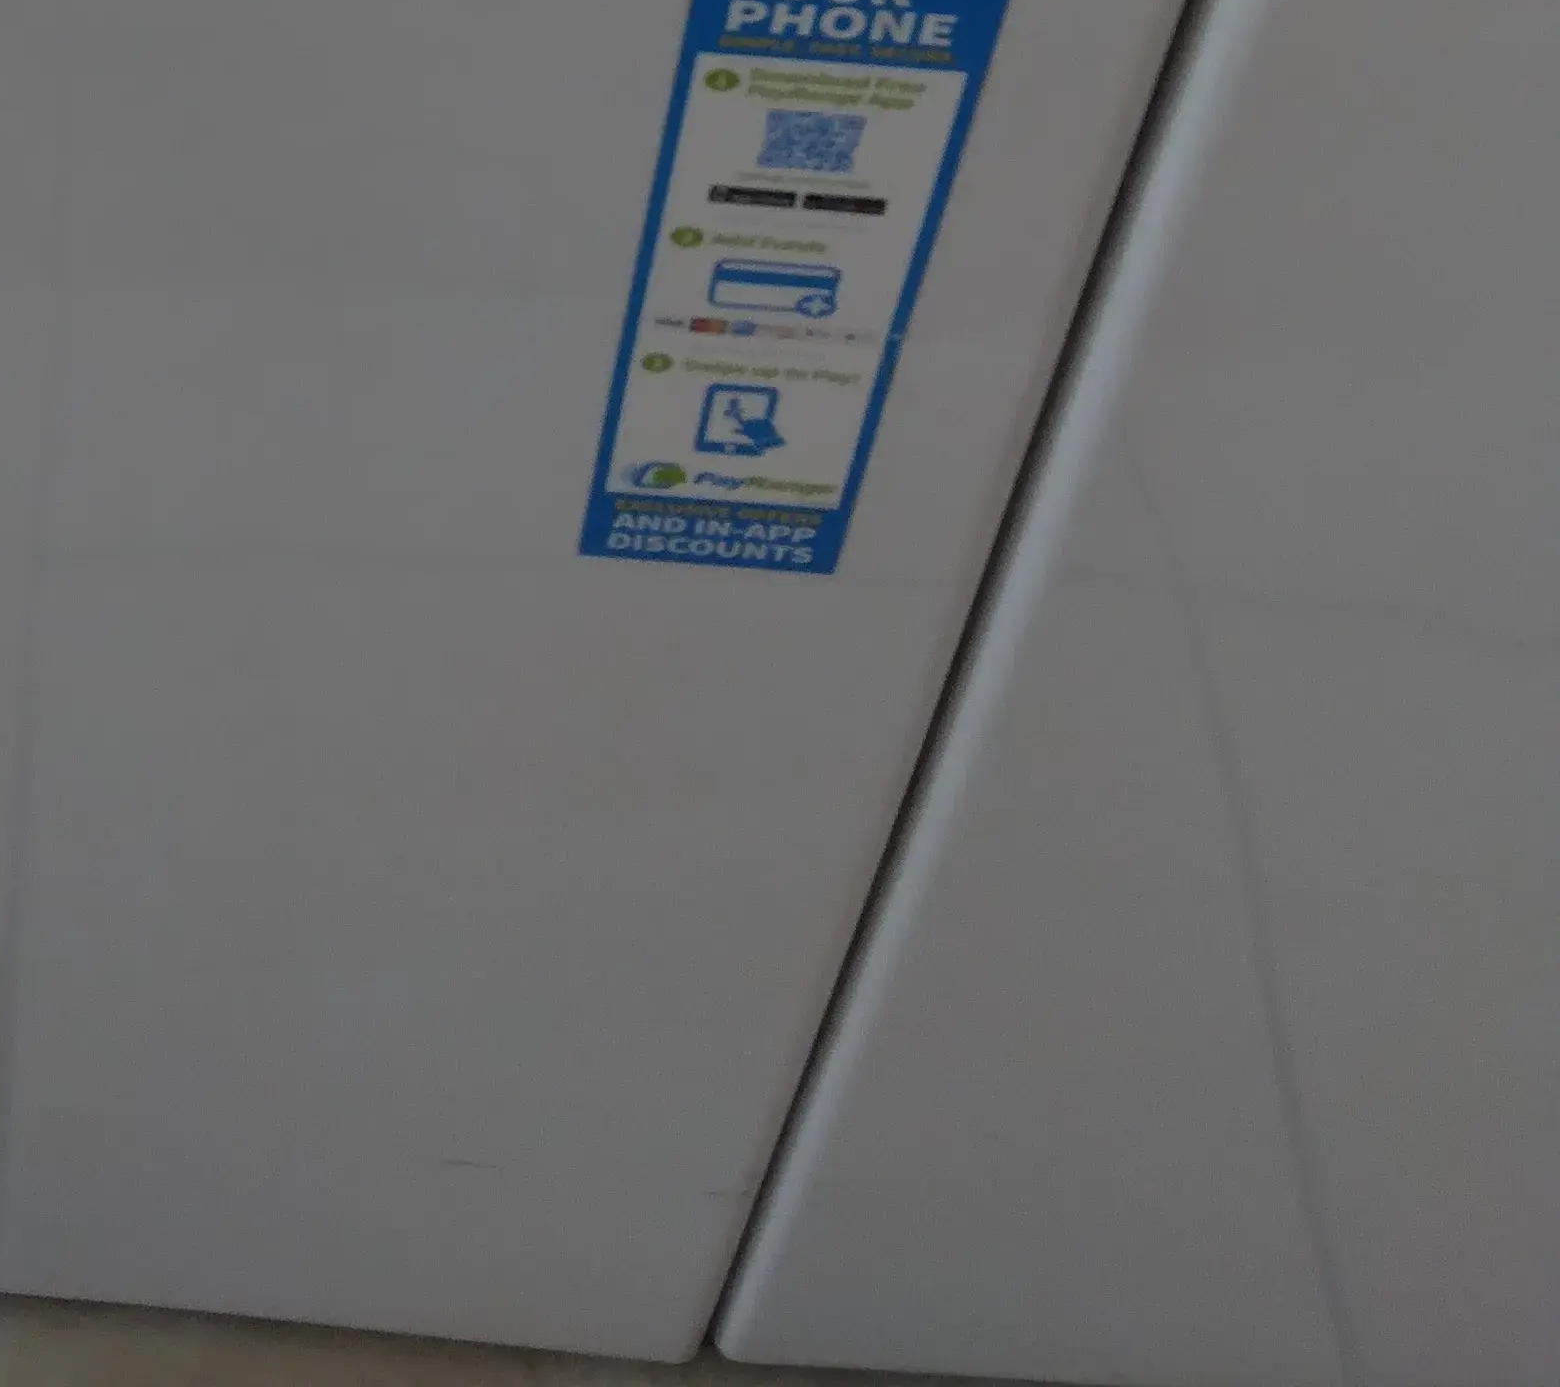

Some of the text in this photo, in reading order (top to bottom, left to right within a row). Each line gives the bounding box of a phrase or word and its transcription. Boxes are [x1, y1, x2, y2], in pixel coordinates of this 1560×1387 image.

[724, 0, 959, 48] PHONE
[693, 470, 837, 496] PayRange
[612, 513, 818, 544] AND IN-APP
[606, 531, 815, 564] DISCOUNTS
